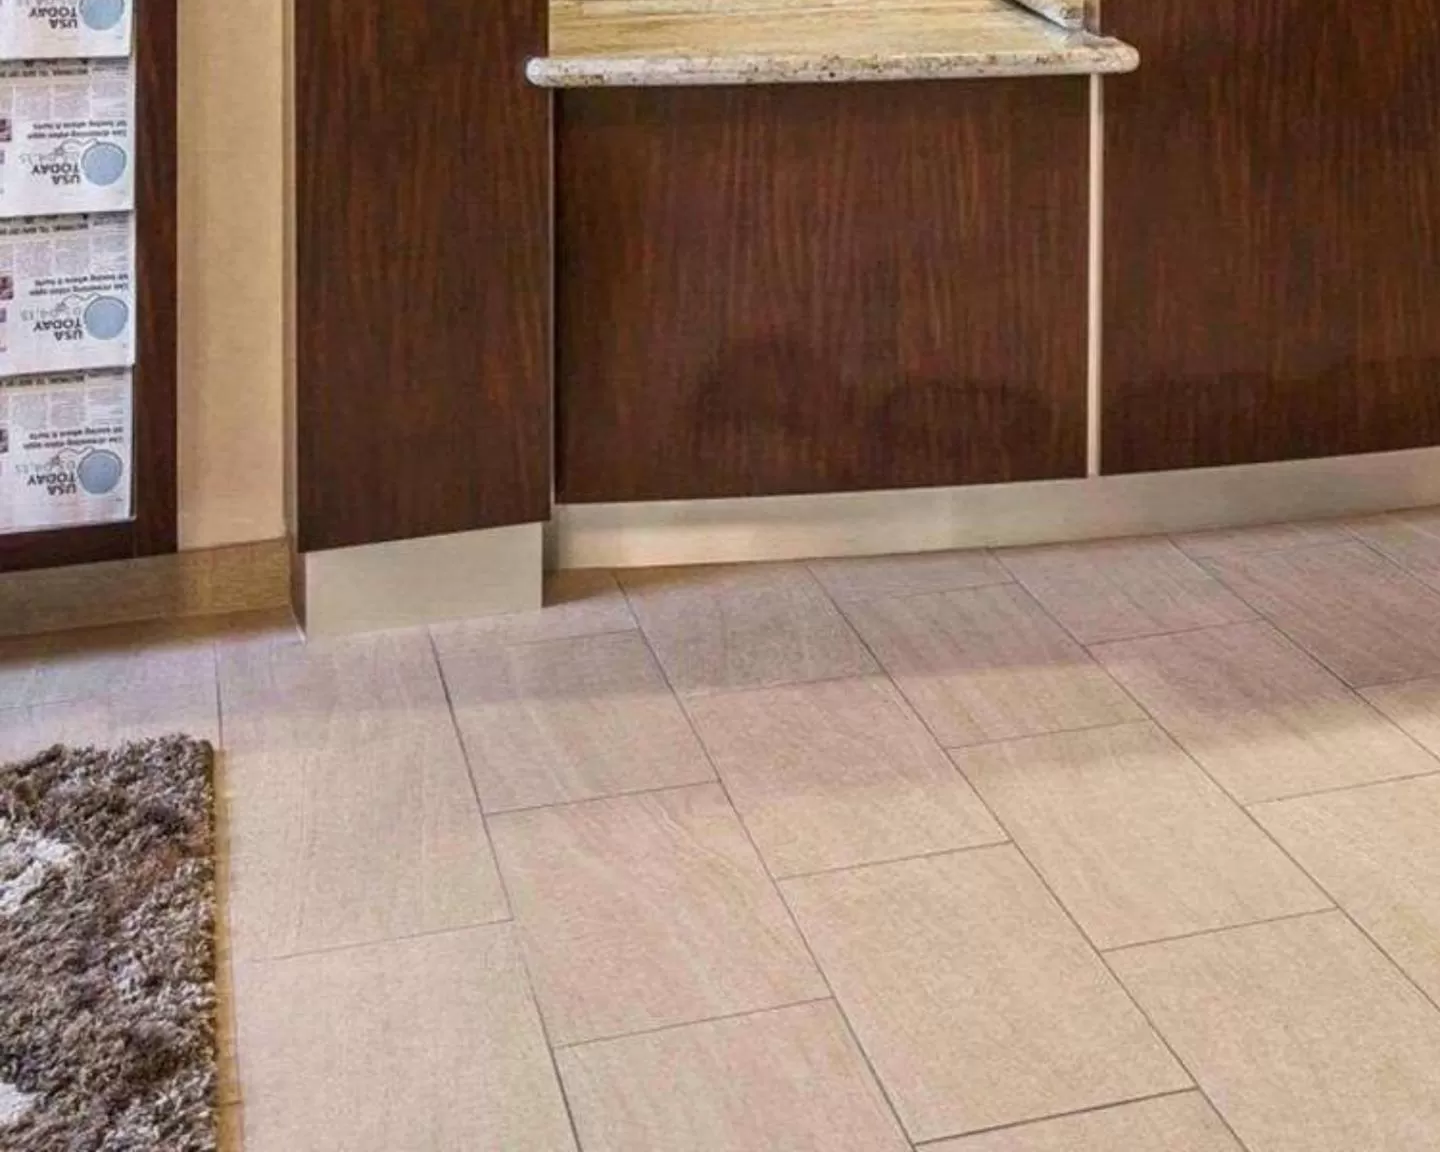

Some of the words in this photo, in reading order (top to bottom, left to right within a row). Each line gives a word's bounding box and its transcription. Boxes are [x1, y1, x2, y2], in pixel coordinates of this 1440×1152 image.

[29, 7, 76, 17] TODAY
[49, 19, 78, 28] USA
[32, 164, 79, 174] TODAY
[51, 174, 79, 184] USA
[33, 318, 81, 331] TODAY
[54, 330, 82, 340] USA
[27, 472, 76, 485] TODAY
[47, 483, 76, 495] USA
